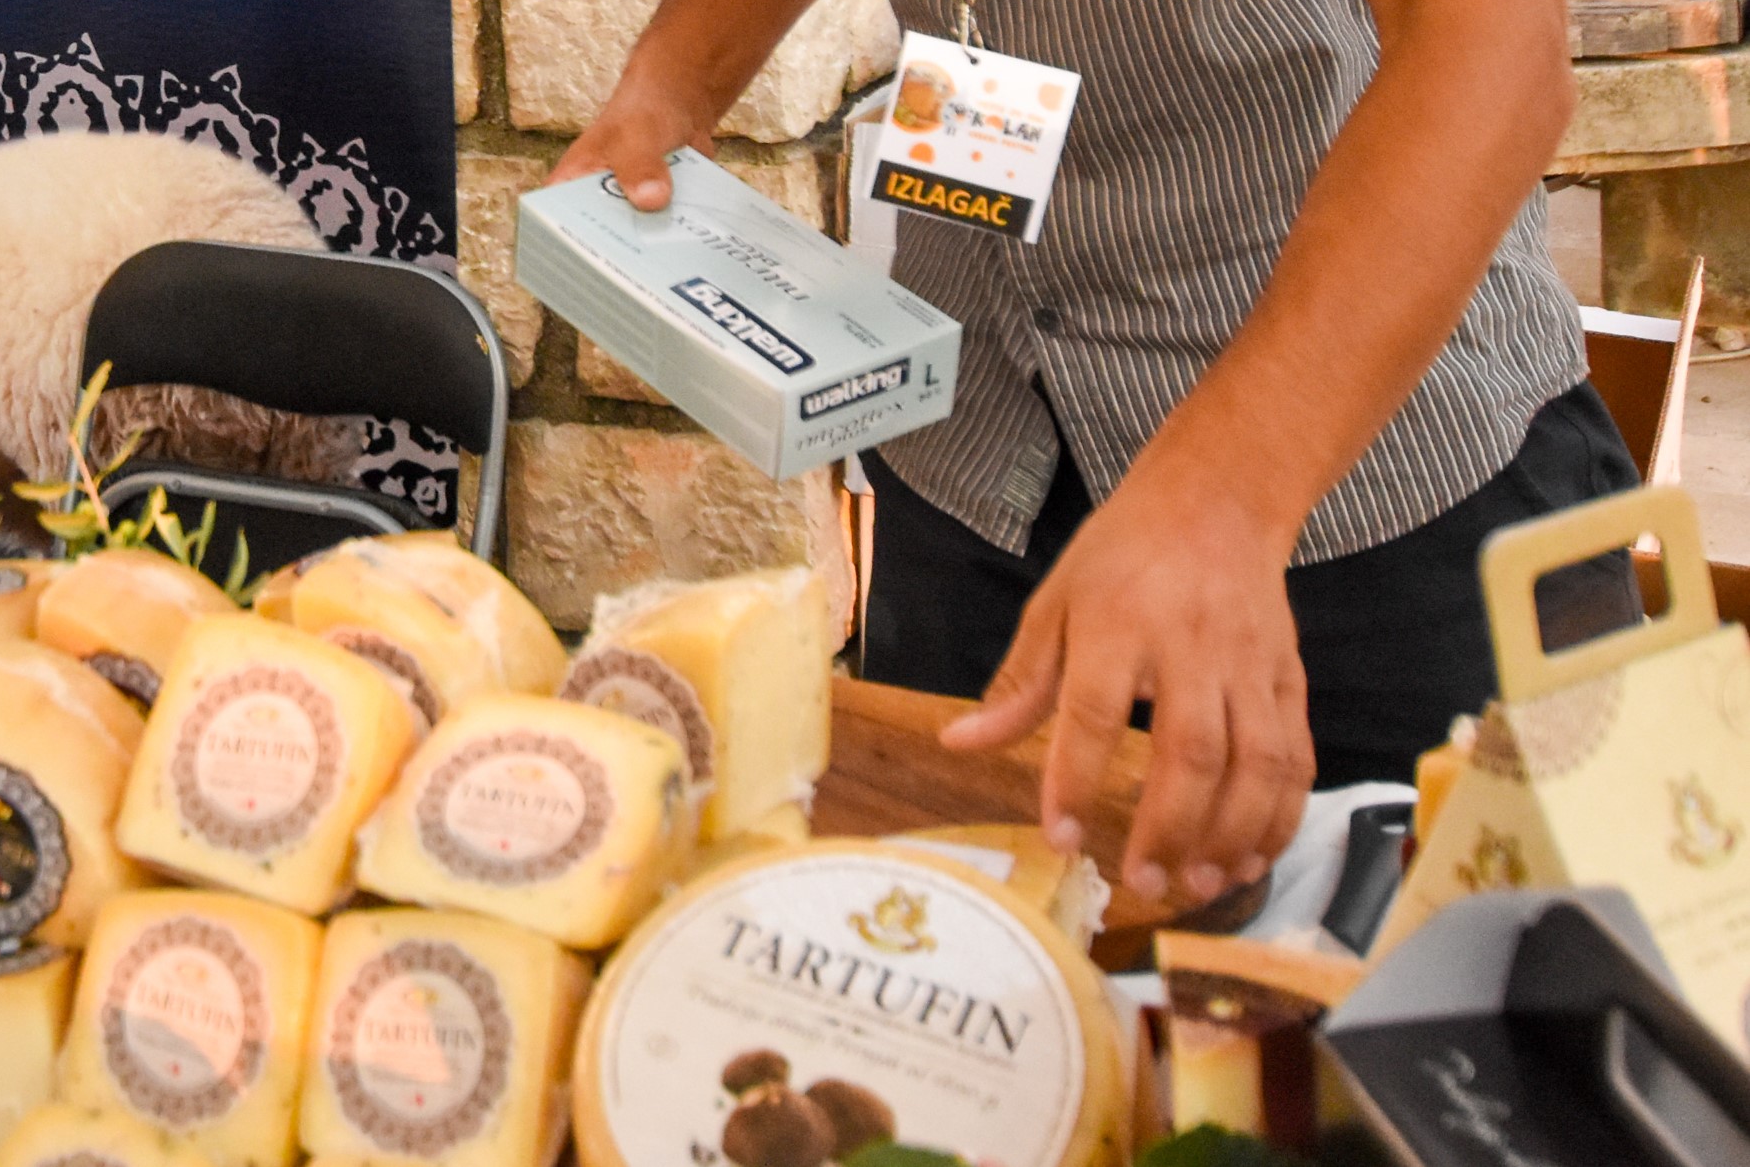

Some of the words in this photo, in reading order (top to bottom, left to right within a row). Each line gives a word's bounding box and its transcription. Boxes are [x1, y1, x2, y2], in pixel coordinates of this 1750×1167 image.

[885, 171, 1014, 226] IZLAGAČ
[684, 283, 804, 369] walking
[804, 364, 902, 415] walking
[723, 914, 1033, 1054] TARTUFIN
